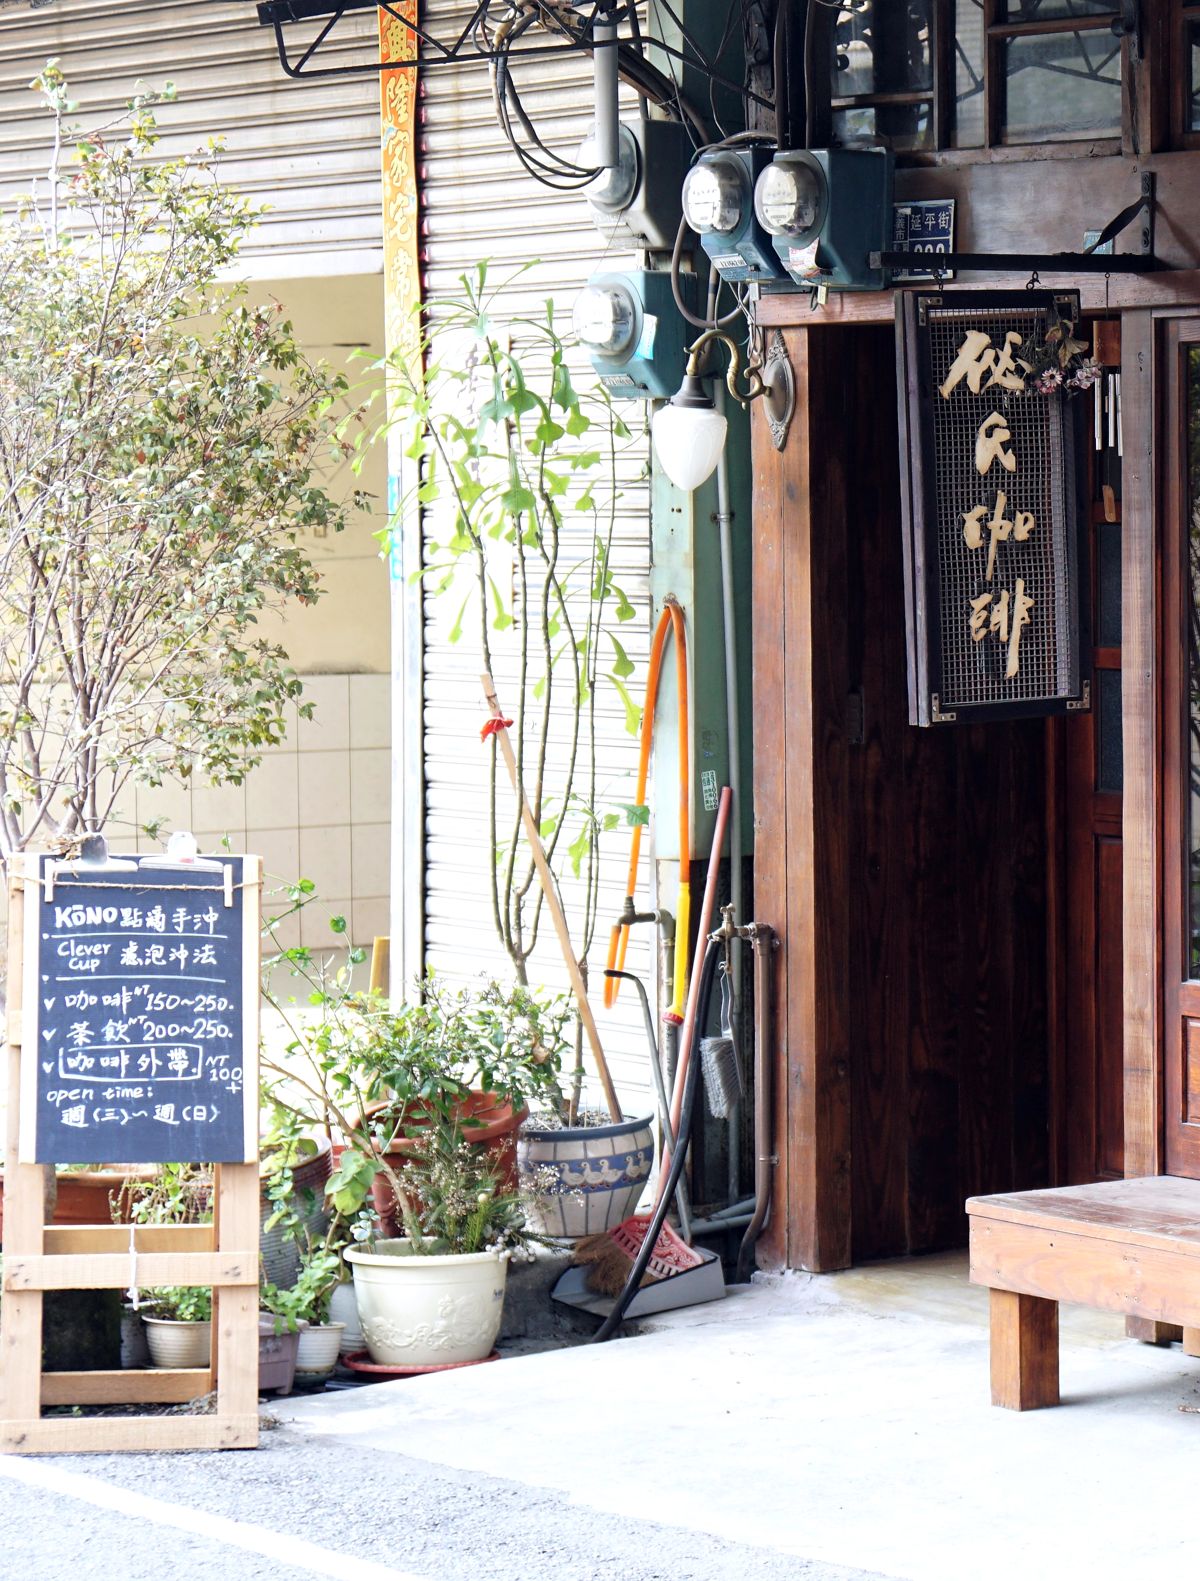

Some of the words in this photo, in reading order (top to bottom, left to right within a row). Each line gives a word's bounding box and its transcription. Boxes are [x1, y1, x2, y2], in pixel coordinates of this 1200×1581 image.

[911, 211, 950, 231] 延平街
[119, 905, 219, 934] 點滴手沖
[57, 939, 111, 956] Clever
[120, 940, 217, 970] 濾泡沖法
[64, 985, 133, 1014] 咖啡
[66, 1018, 131, 1046] 茶飲
[205, 1055, 230, 1067] NT
[46, 1088, 94, 1108] open
[102, 1086, 154, 1101] time:
